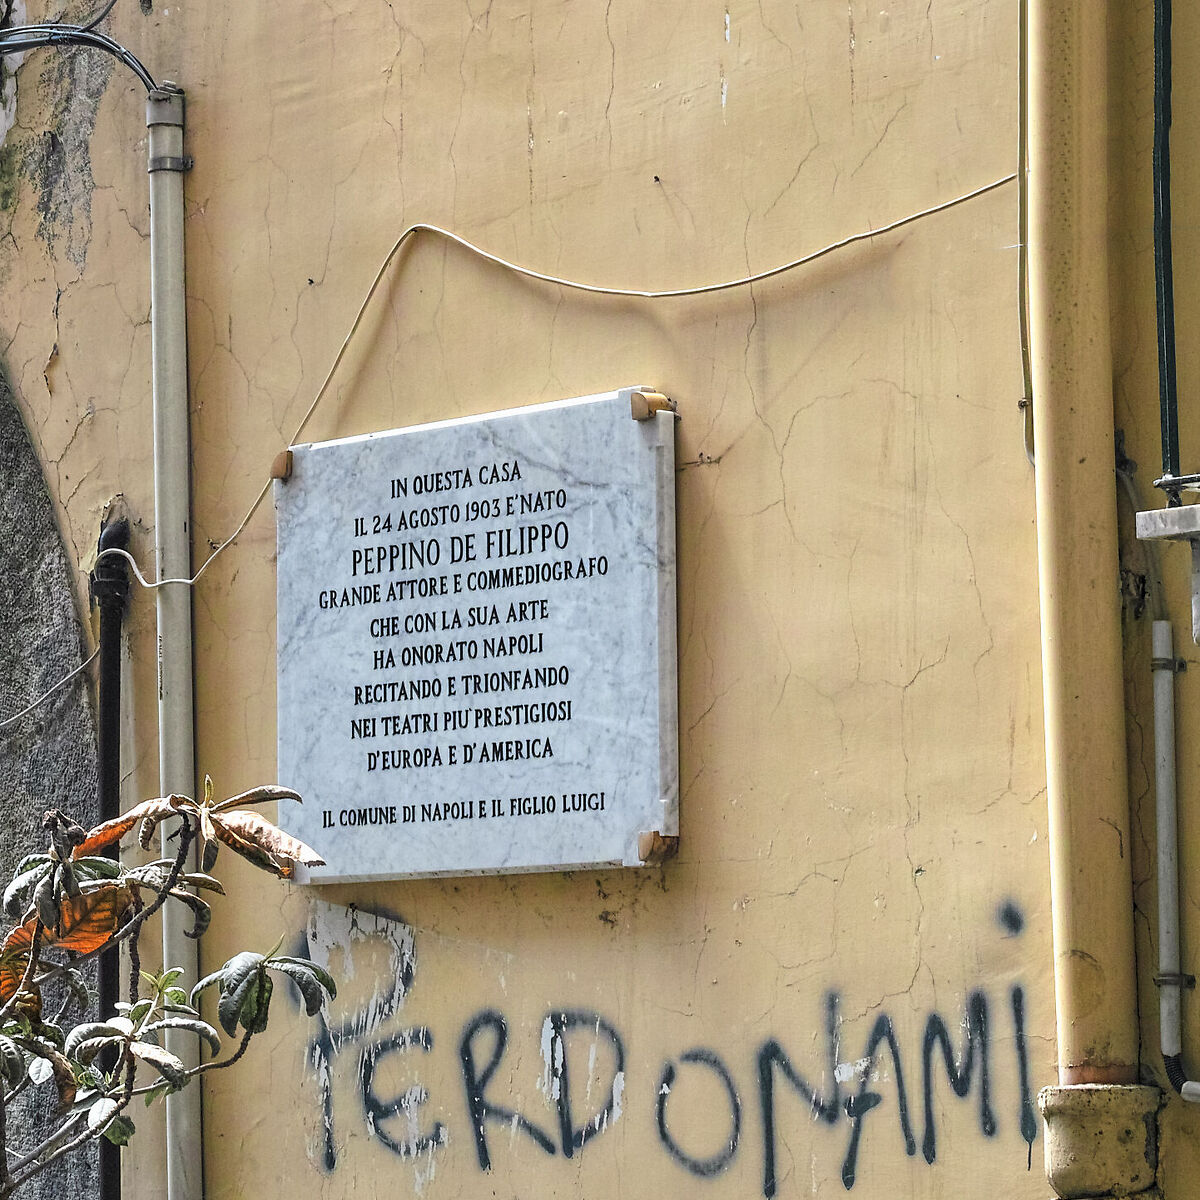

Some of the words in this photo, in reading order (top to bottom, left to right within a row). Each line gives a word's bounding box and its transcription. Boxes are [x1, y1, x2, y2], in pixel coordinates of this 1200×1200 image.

[390, 477, 408, 500] IN
[412, 467, 473, 496] QUESTA
[478, 460, 522, 485] CASA
[354, 517, 369, 538] IL
[372, 512, 393, 535] 24
[396, 503, 461, 532] AGOSTO
[465, 498, 501, 522] 1903
[351, 538, 441, 577] PEPPINO
[449, 533, 477, 565] DE
[485, 521, 569, 560] FILIPPO
[318, 583, 382, 610] GRANDE
[385, 575, 449, 603] ATTORE
[452, 573, 463, 595] E
[466, 555, 609, 592] COMMEDIOGRAFO
[369, 616, 400, 639] CHE
[404, 611, 437, 635] CON
[441, 608, 463, 631] LA
[467, 603, 501, 628] SUA
[505, 599, 550, 624] ARTE
[373, 647, 396, 671] HA
[401, 639, 478, 667] ONORATO
[482, 632, 544, 660] NAPOLI
[353, 677, 442, 706] RECITANDO
[447, 676, 457, 697] E
[460, 665, 570, 696] TRIONFANDO
[350, 717, 377, 740] NEI
[380, 712, 439, 737] TEATRI
[367, 745, 444, 773] D'EUROPA
[448, 744, 458, 766] E
[322, 810, 336, 829] IL
[339, 805, 398, 827] COMUNE
[402, 804, 416, 824] DI
[420, 800, 474, 823] NAPOLI
[478, 799, 487, 819] E
[491, 799, 505, 818] IL
[509, 795, 557, 817] FIGLIO
[562, 791, 606, 814] LUIGI
